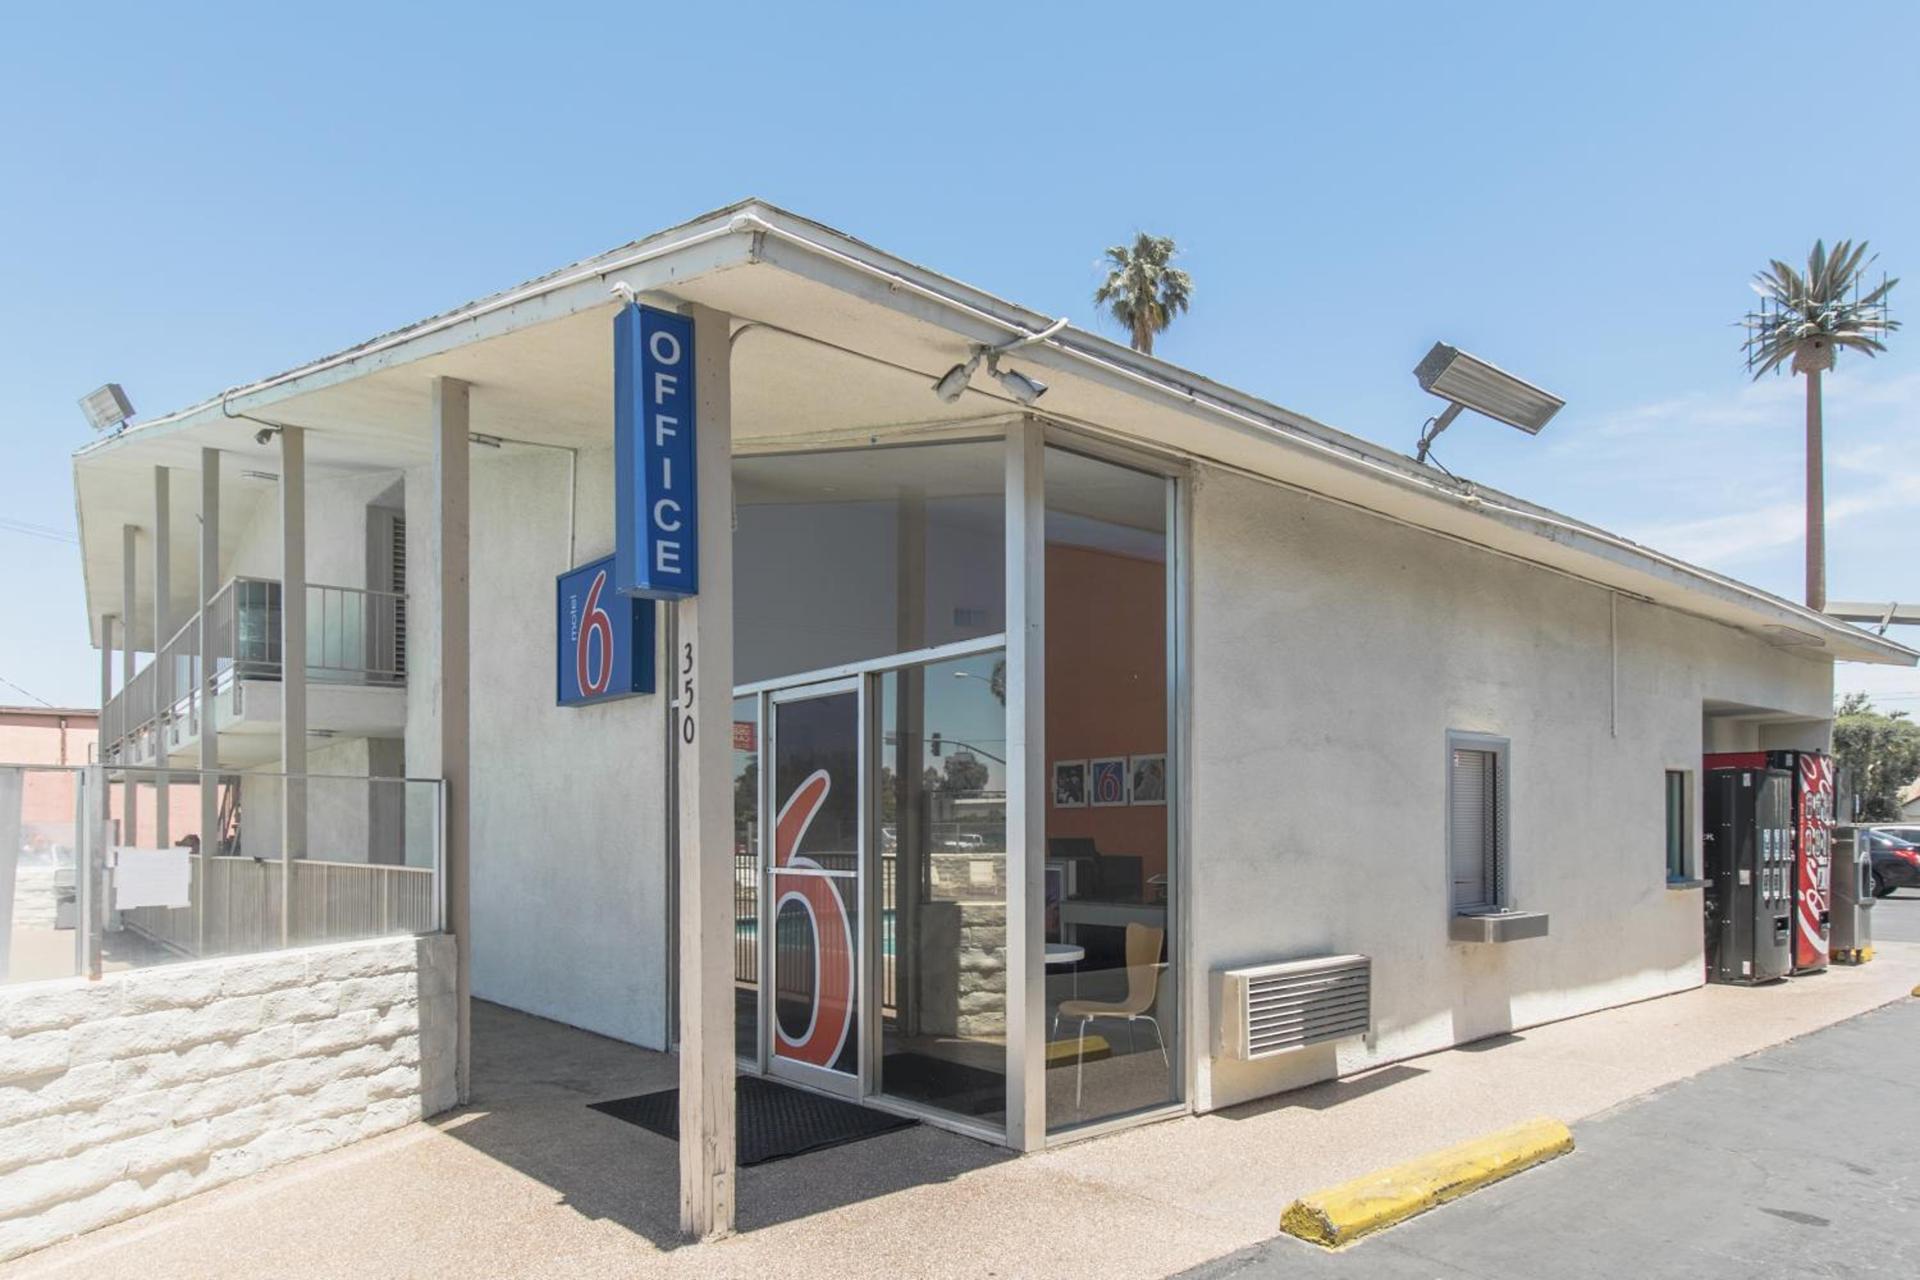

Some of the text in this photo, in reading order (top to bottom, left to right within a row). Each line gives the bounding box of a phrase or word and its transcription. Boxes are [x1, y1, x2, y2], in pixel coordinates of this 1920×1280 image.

[650, 331, 681, 574] OFFICE
[569, 595, 577, 641] motel
[577, 570, 613, 697] 6
[682, 642, 695, 744] 350
[1098, 761, 1119, 801] 6
[776, 769, 854, 1069] 6
